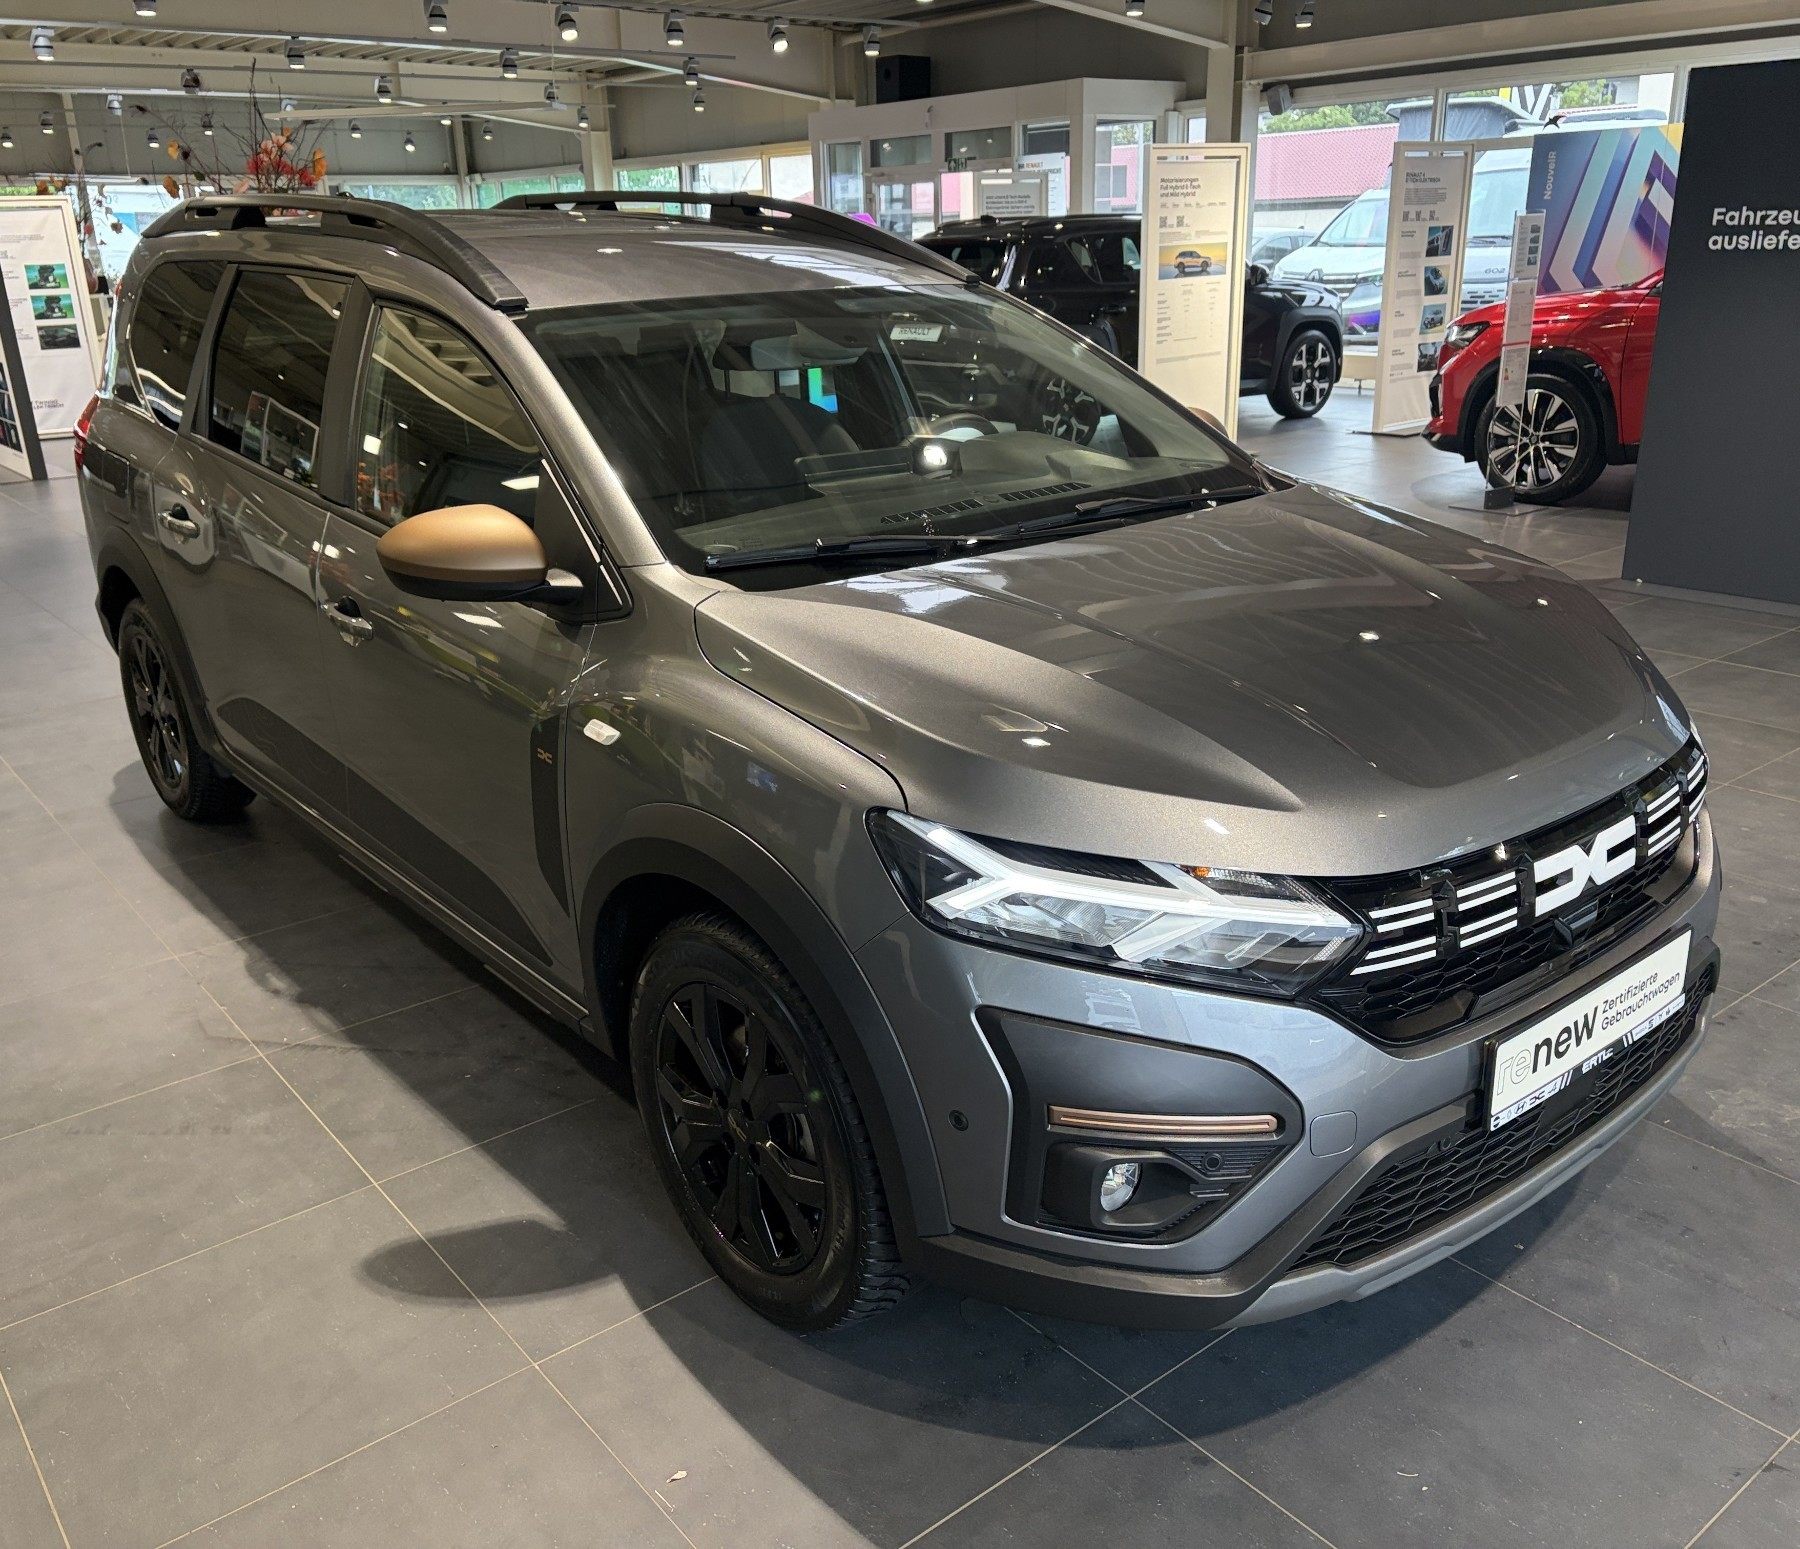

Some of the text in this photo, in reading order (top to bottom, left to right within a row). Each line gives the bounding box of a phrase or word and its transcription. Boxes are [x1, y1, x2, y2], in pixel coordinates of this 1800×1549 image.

[1708, 229, 1800, 250] ausliefe
[1601, 972, 1680, 1031] Gebrauchtwagen
[1496, 972, 1658, 1096] renew Zertifizierte
